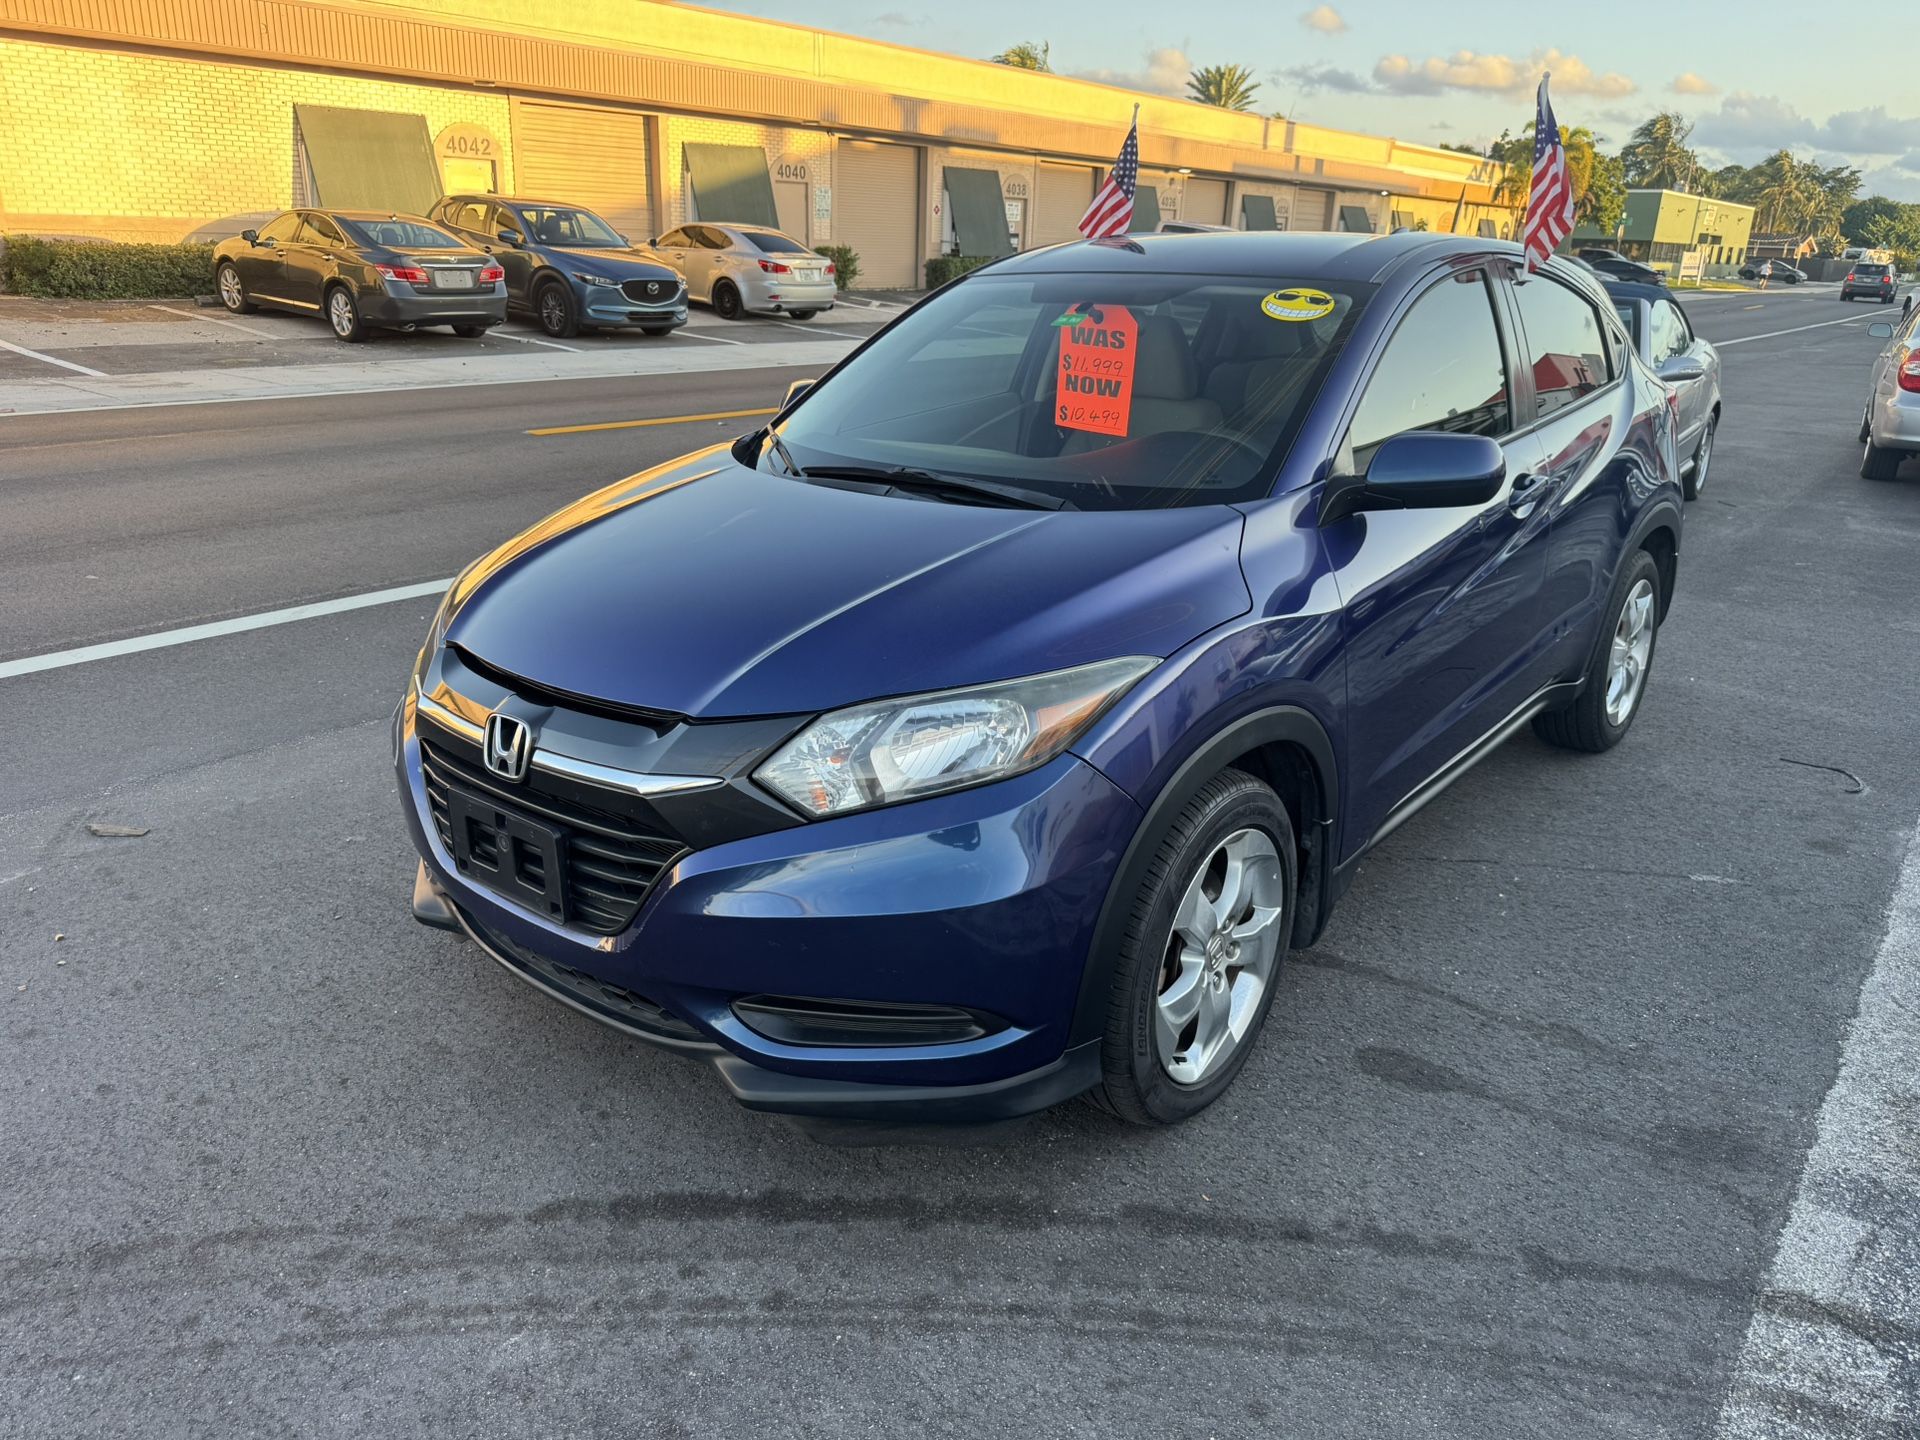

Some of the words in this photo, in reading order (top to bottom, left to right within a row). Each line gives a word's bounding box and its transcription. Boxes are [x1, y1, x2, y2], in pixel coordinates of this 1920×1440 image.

[446, 135, 492, 156] 4042
[777, 163, 806, 180] 4040
[1005, 183, 1028, 197] 4038
[1071, 326, 1126, 350] WAS
[1064, 373, 1122, 398] NOW
